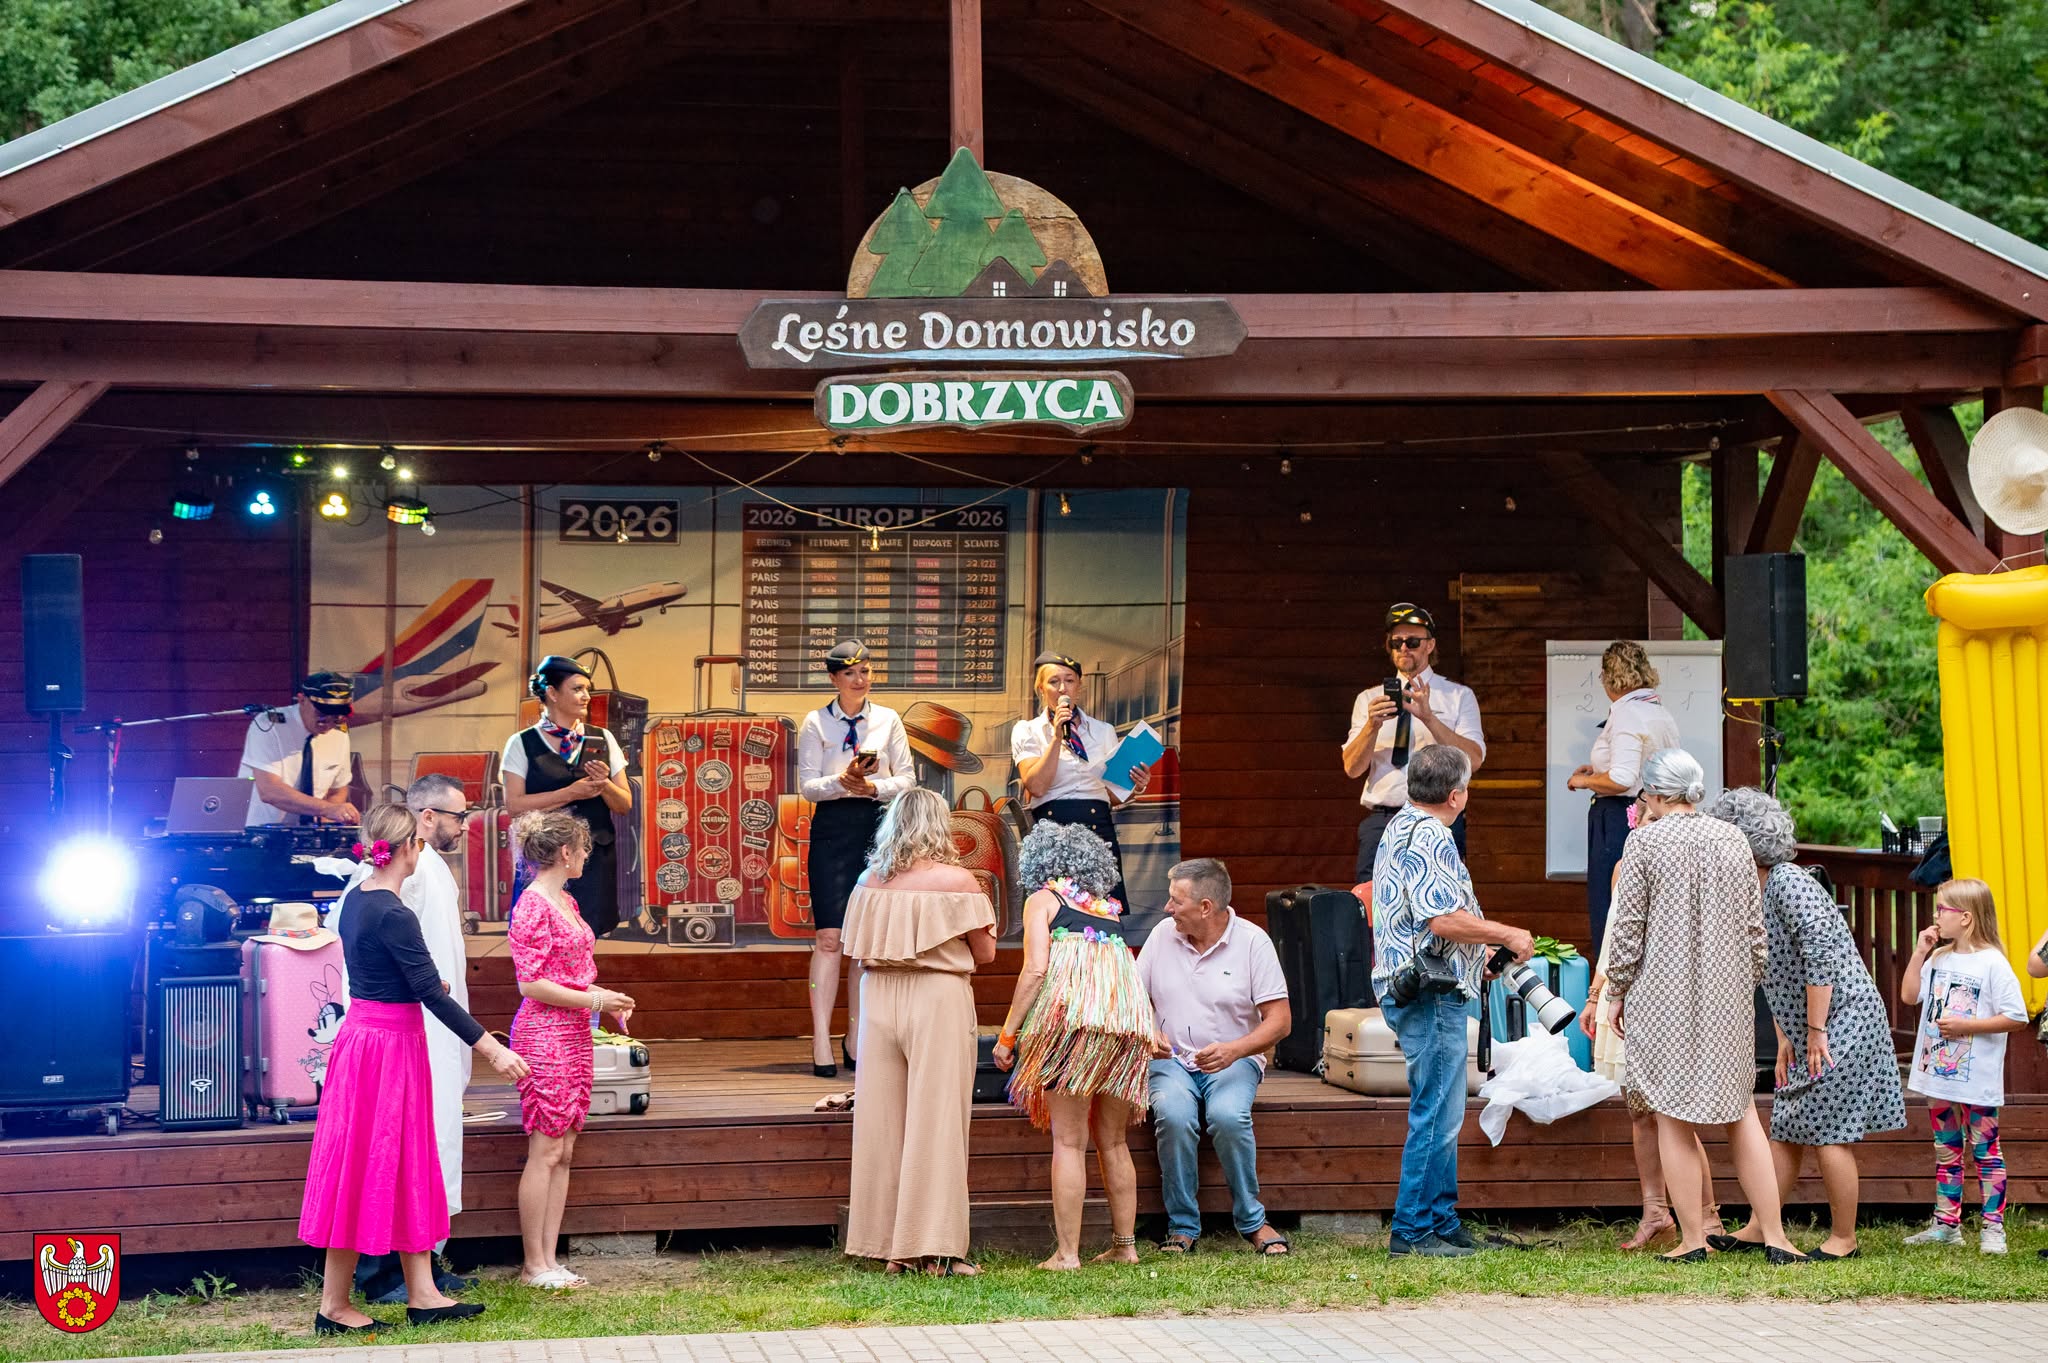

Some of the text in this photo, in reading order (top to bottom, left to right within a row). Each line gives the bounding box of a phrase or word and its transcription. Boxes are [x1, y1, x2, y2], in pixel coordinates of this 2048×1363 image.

[772, 305, 1197, 363] Leśne Domowisko
[830, 379, 1124, 424] DOBRZYCA
[565, 503, 674, 538] 2026
[748, 507, 1004, 528] 2026 EUROPE 2026
[751, 558, 782, 568] PARIS
[750, 573, 780, 582] PARIS
[1575, 693, 1594, 712] 2
